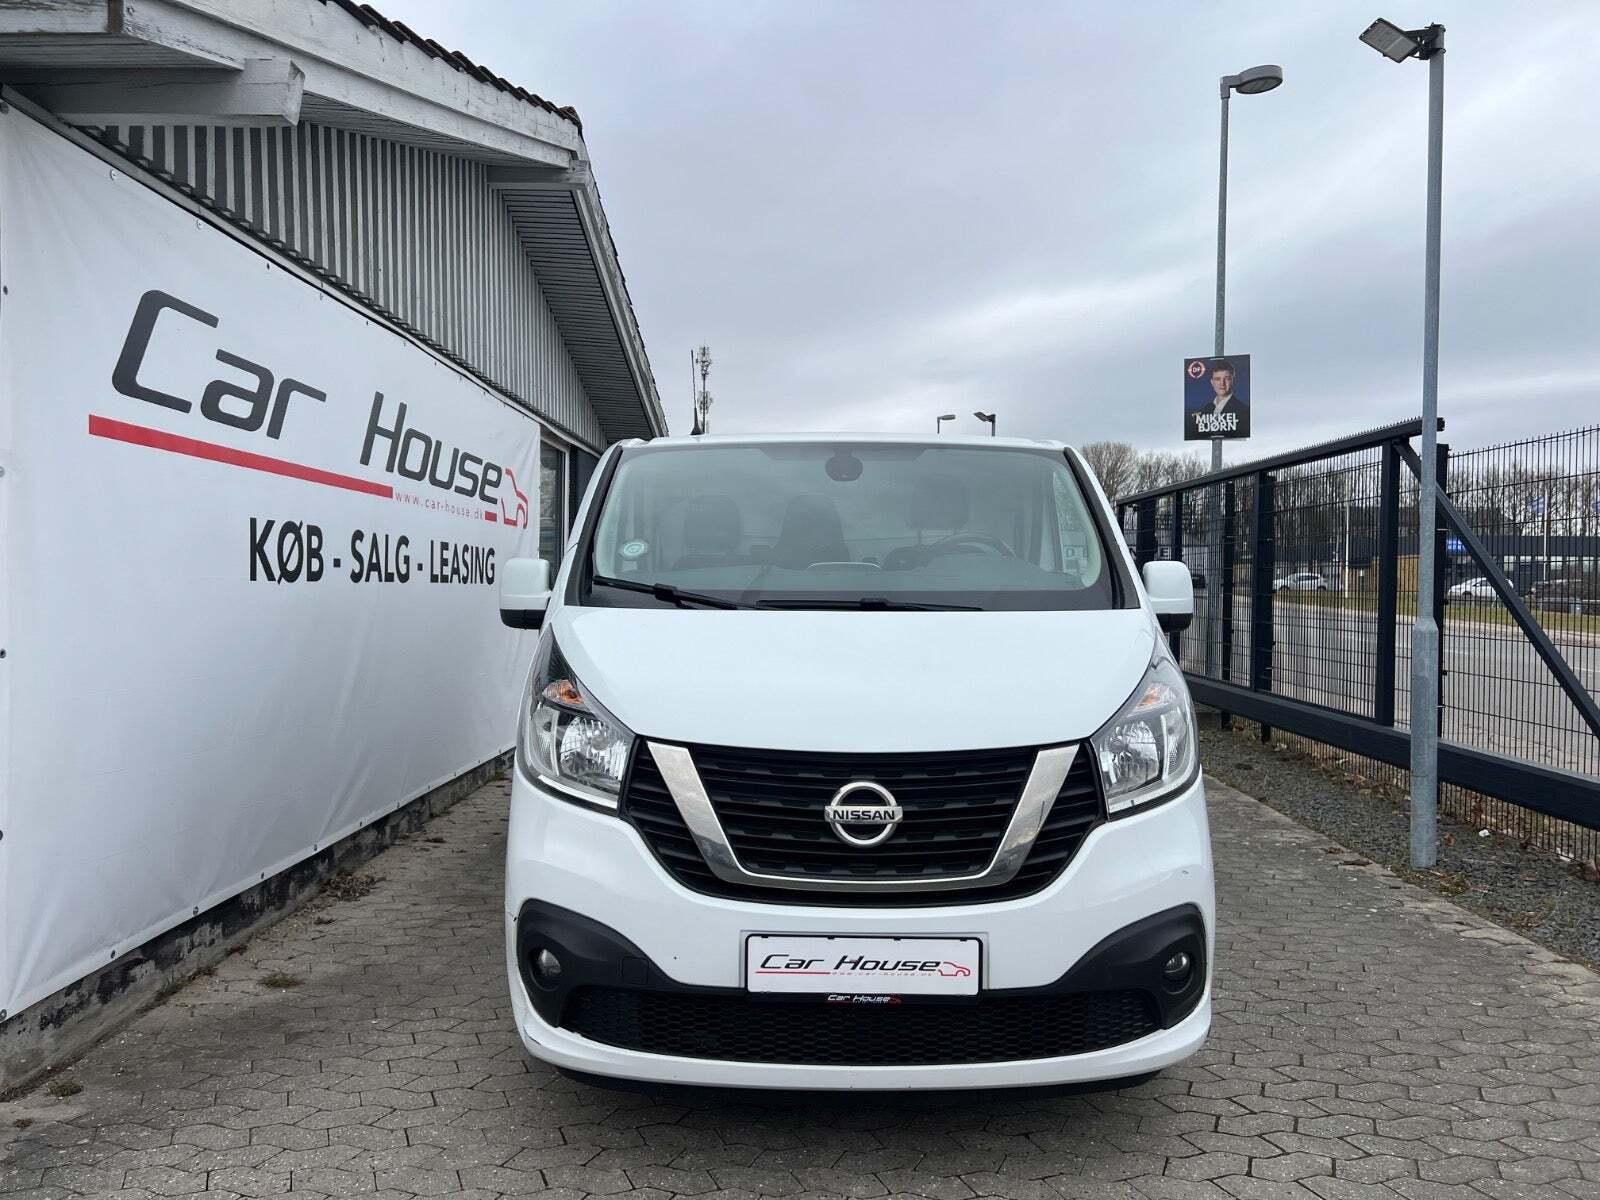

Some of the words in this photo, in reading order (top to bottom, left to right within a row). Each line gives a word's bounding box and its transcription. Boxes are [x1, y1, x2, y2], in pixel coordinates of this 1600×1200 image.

[112, 289, 327, 440] Car
[360, 391, 503, 505] House
[1195, 413, 1239, 424] MIKKEL
[1198, 421, 1237, 432] BJØRN
[395, 492, 485, 521] www.car-house.dk
[249, 517, 323, 584] KØB
[350, 529, 410, 584] SALG
[430, 540, 496, 585] LEASING
[833, 810, 895, 820] NISSAN
[760, 954, 825, 969] Car
[834, 955, 941, 971] House
[852, 995, 891, 1003] House
